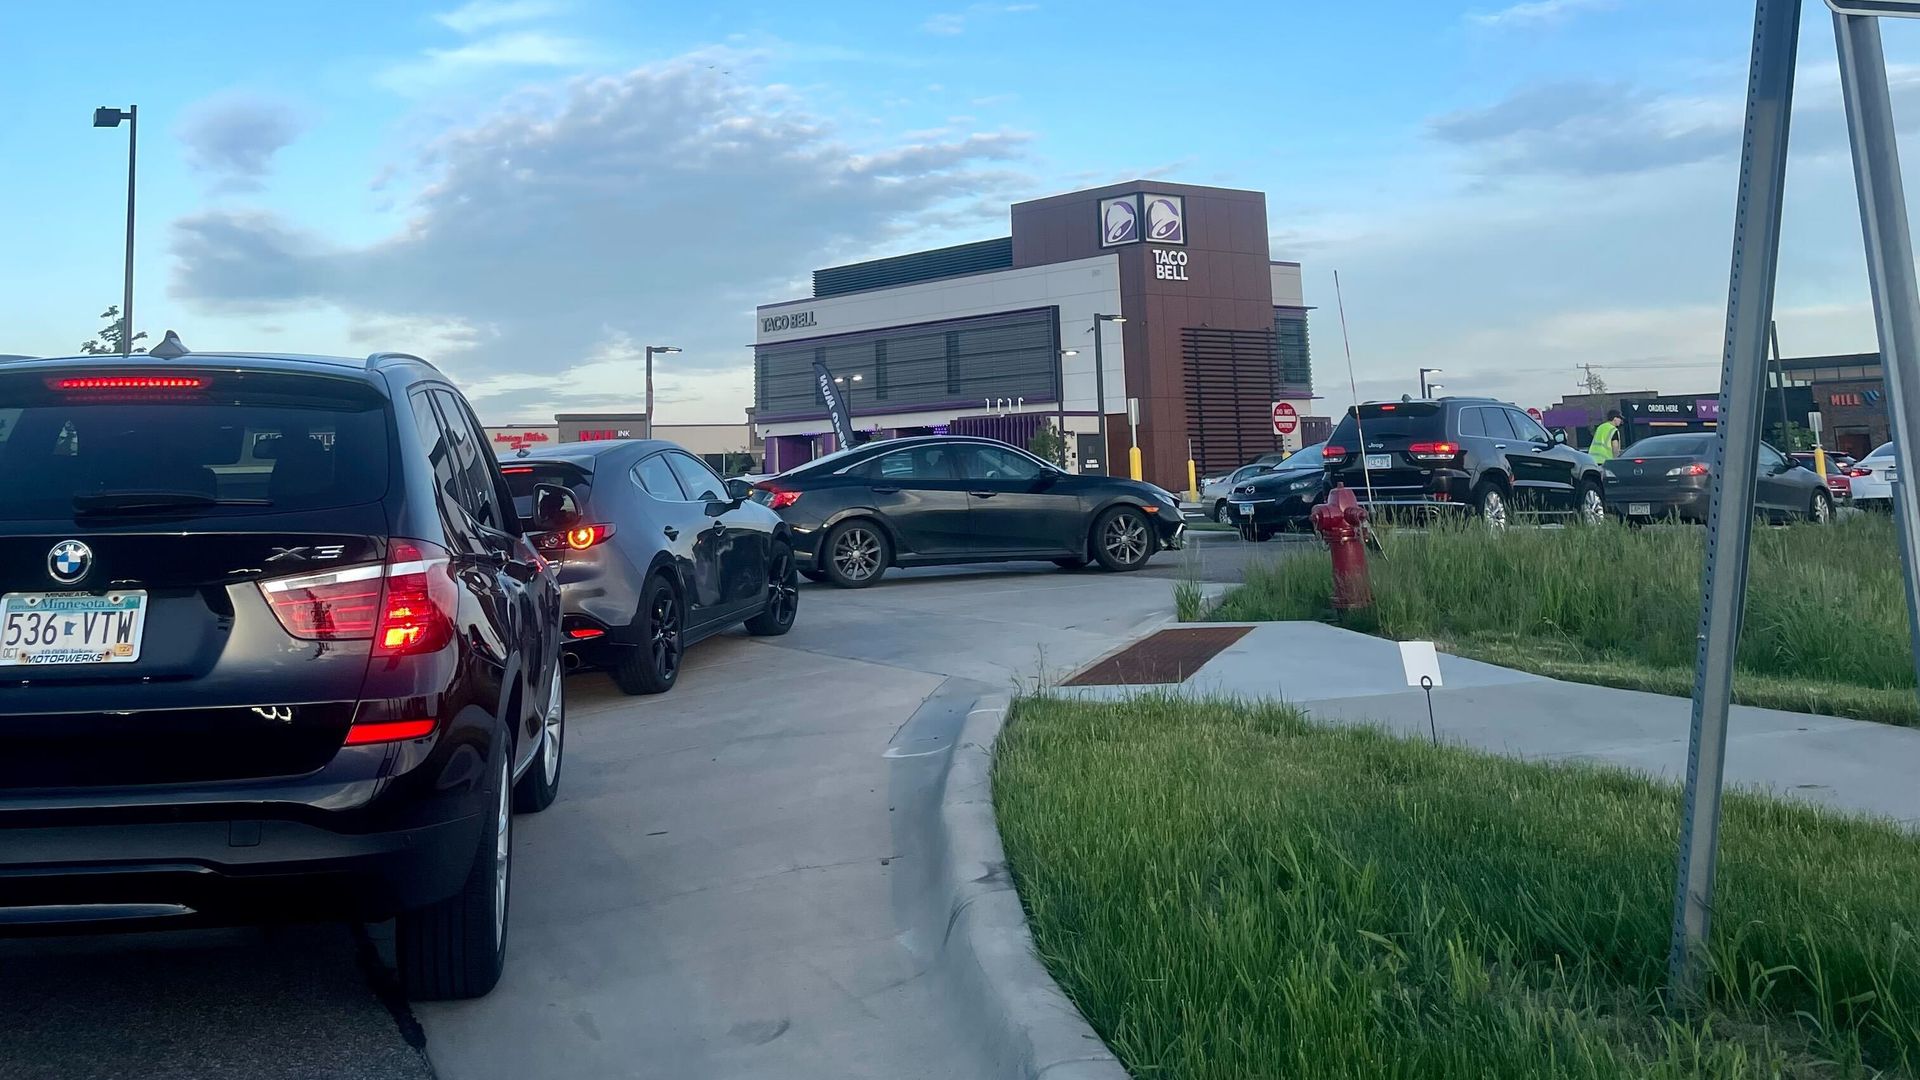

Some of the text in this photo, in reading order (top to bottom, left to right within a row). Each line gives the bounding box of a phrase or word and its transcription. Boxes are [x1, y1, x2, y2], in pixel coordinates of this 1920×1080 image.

[1152, 249, 1188, 266] TACO
[1156, 264, 1189, 281] BELL
[761, 311, 817, 332] TACO BELL
[1830, 394, 1861, 406] MILL
[1647, 404, 1679, 413] ORDER HERE
[54, 544, 88, 557] BMW
[264, 545, 345, 562] X3
[40, 598, 105, 609] Minnesota
[5, 611, 134, 646] 536 VTW
[25, 653, 104, 663] MOTORWERKS
